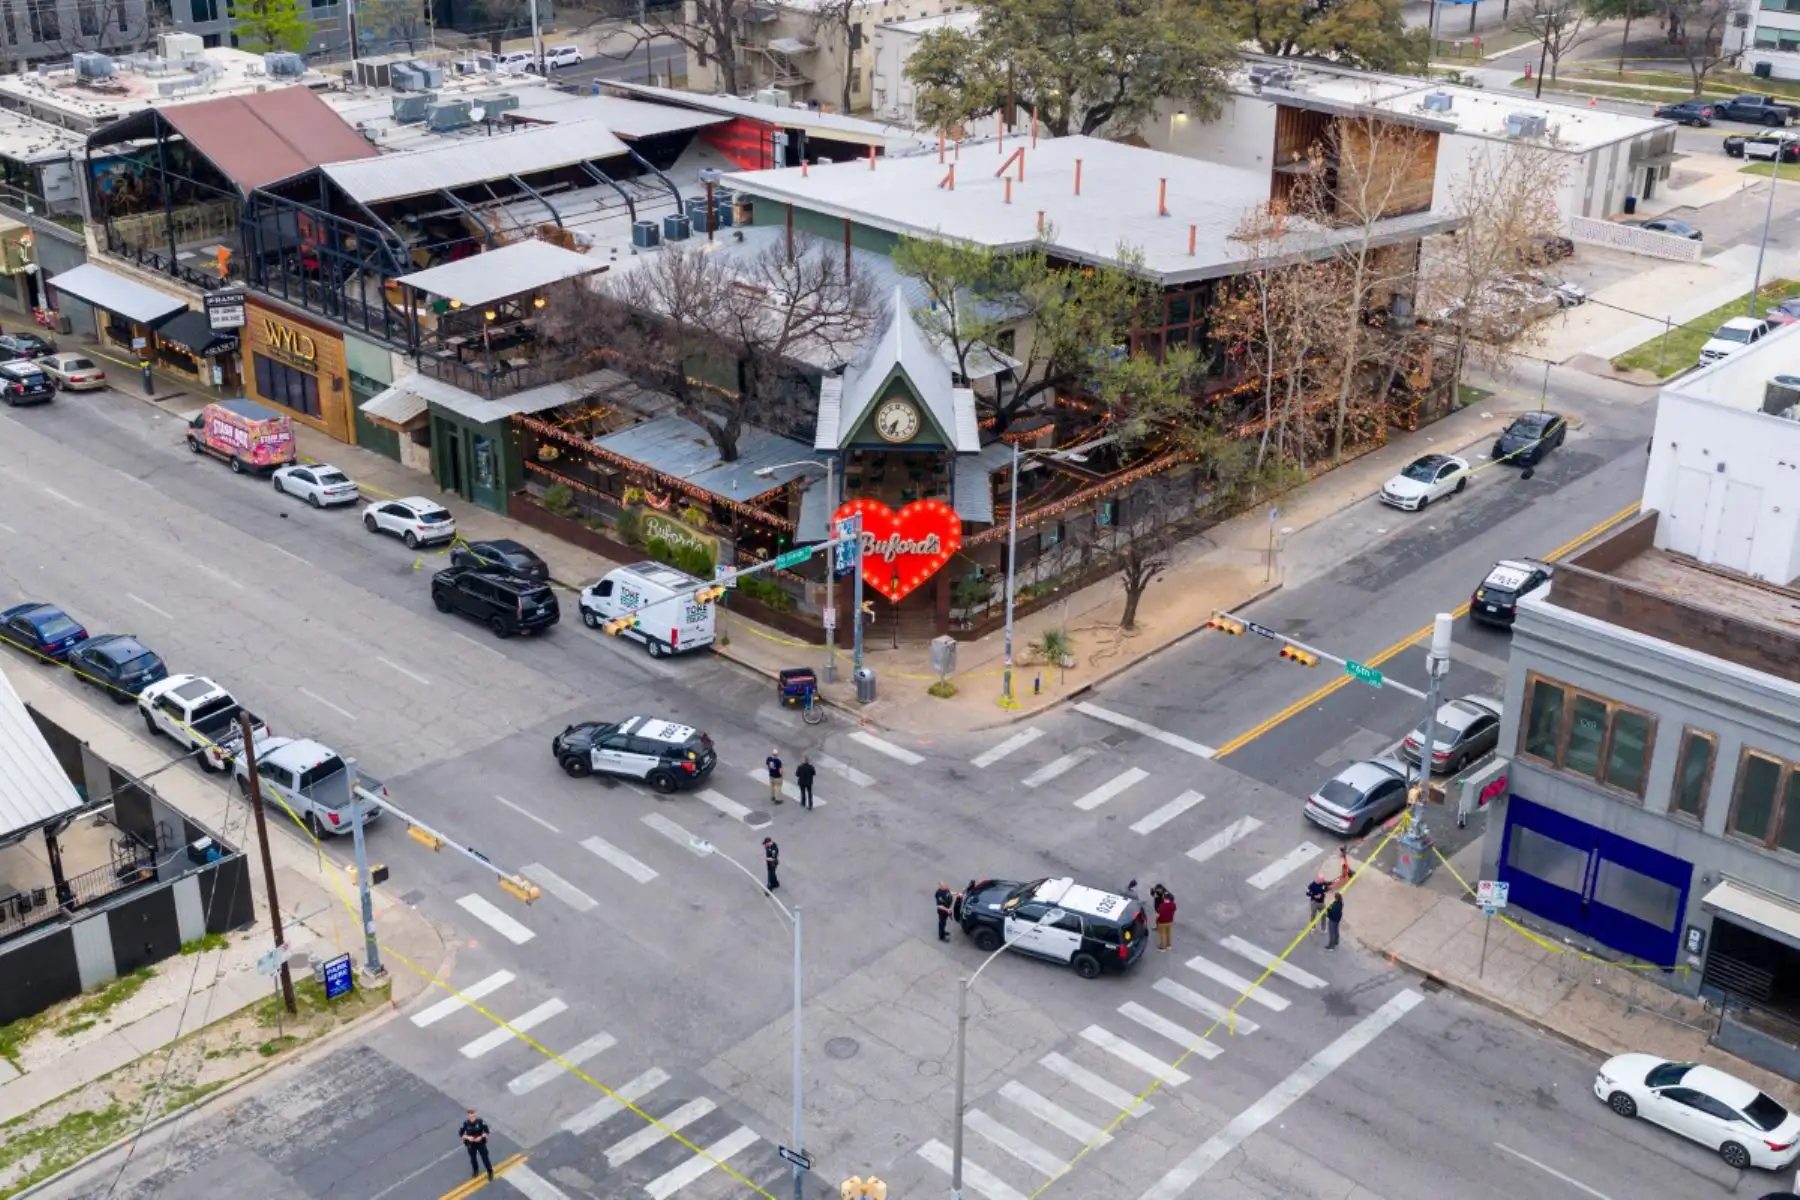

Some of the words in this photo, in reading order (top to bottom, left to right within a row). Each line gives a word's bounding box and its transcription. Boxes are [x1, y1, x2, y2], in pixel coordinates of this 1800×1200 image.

[215, 294, 244, 304] RANCH
[263, 319, 315, 361] WYLD
[861, 531, 940, 563] Buford's
